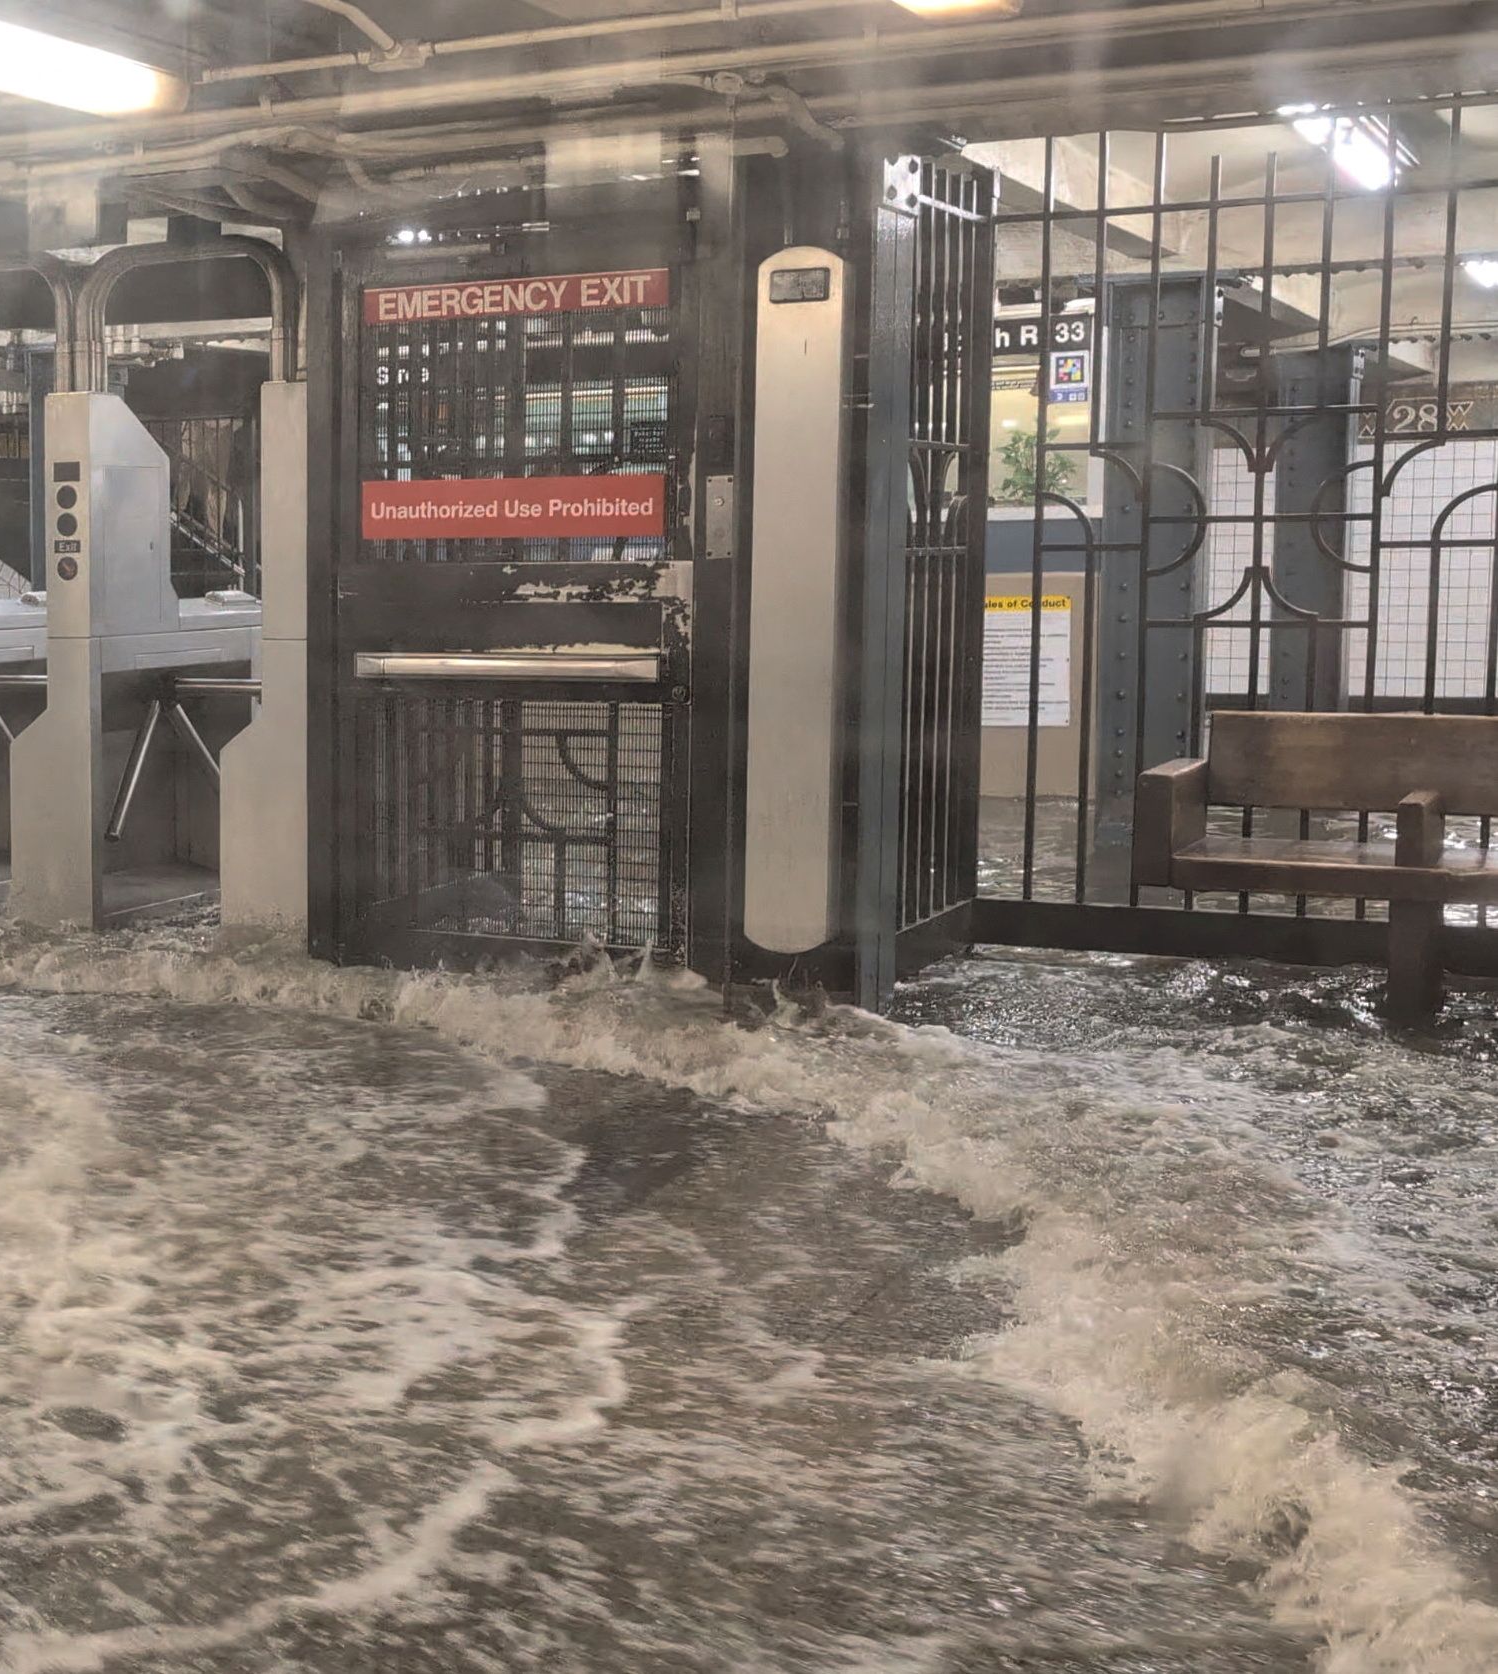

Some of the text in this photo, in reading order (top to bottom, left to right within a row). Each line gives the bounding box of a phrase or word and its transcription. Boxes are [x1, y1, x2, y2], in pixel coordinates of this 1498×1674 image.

[378, 274, 651, 321] EMERGENCY EXIT
[1392, 403, 1439, 433] 28
[370, 498, 654, 520] Unauthorized Use Prohibited
[58, 542, 78, 552] Exit
[1007, 599, 1017, 609] of
[1020, 598, 1066, 609] Coduct
